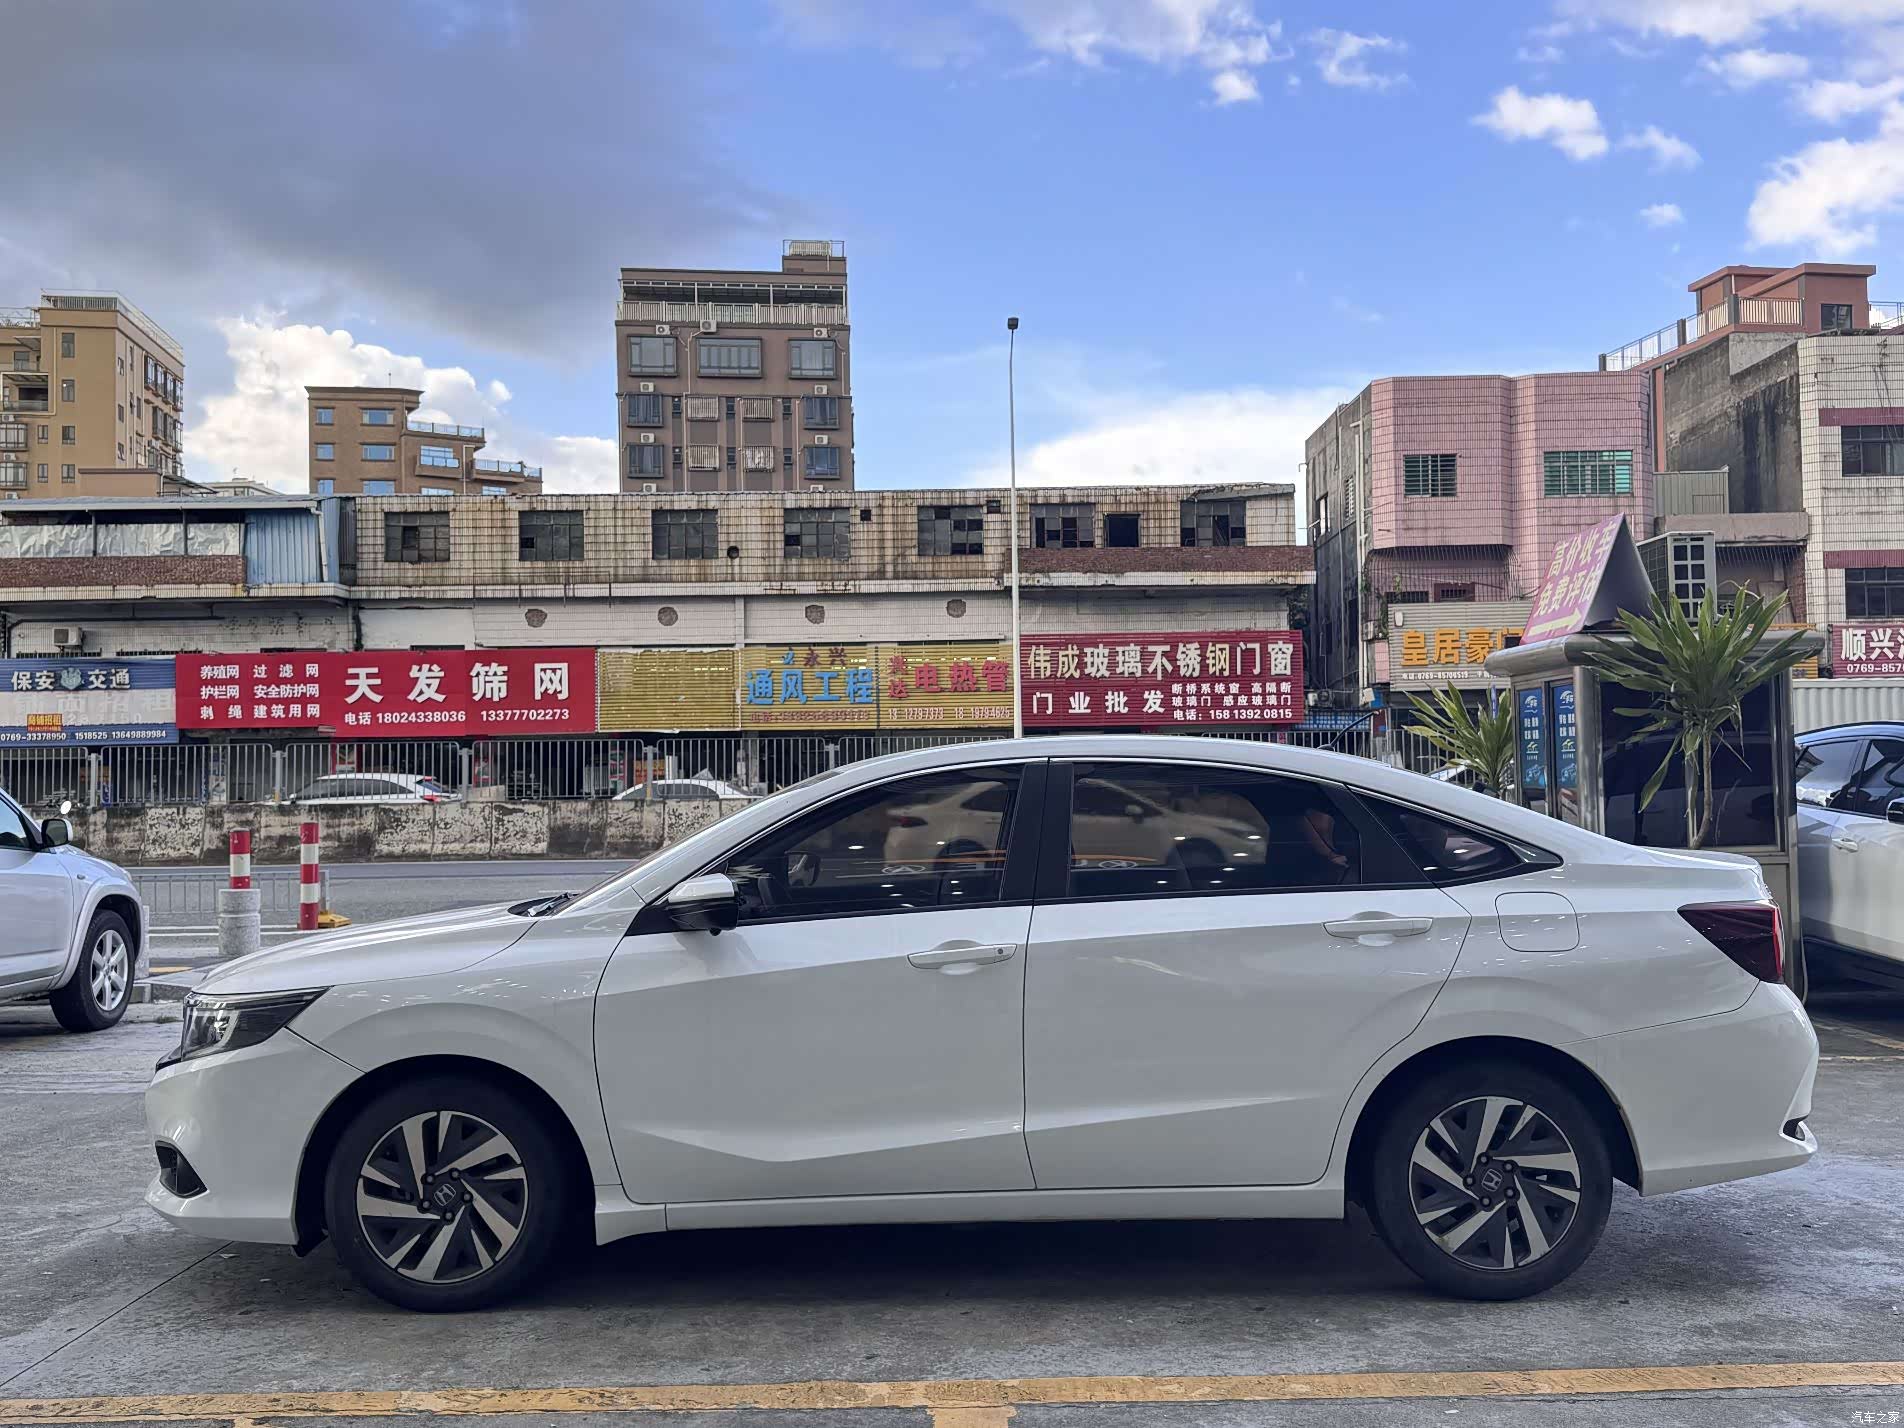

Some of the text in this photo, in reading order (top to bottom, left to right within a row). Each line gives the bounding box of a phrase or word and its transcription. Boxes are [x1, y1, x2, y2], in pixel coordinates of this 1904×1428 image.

[1547, 521, 1617, 579] 高价收车
[1533, 563, 1602, 618] 免费评估
[1841, 628, 1904, 661] 顺兴
[200, 664, 319, 679] 养殖网 过滤网
[1028, 641, 1294, 680] 伟成玻璃不锈钢门窗
[1847, 663, 1904, 673] 0769-857
[11, 668, 130, 690] 保安 交通
[344, 662, 569, 704] 天发筛网
[746, 669, 873, 705] 通风工程
[914, 660, 1009, 693] 电热管
[200, 684, 320, 699] 护栏网 安全防护网
[1171, 682, 1291, 695] 断桥系统窗 高隔断
[253, 704, 320, 718] 建筑用网
[1033, 690, 1165, 714] 门业批发
[1172, 695, 1291, 707] 玻璃门 感应玻璃门
[344, 708, 570, 725] 电话 18024338036 13377702273
[1209, 709, 1230, 719] 158
[1233, 709, 1261, 719] 1392
[1263, 708, 1293, 719] 0815
